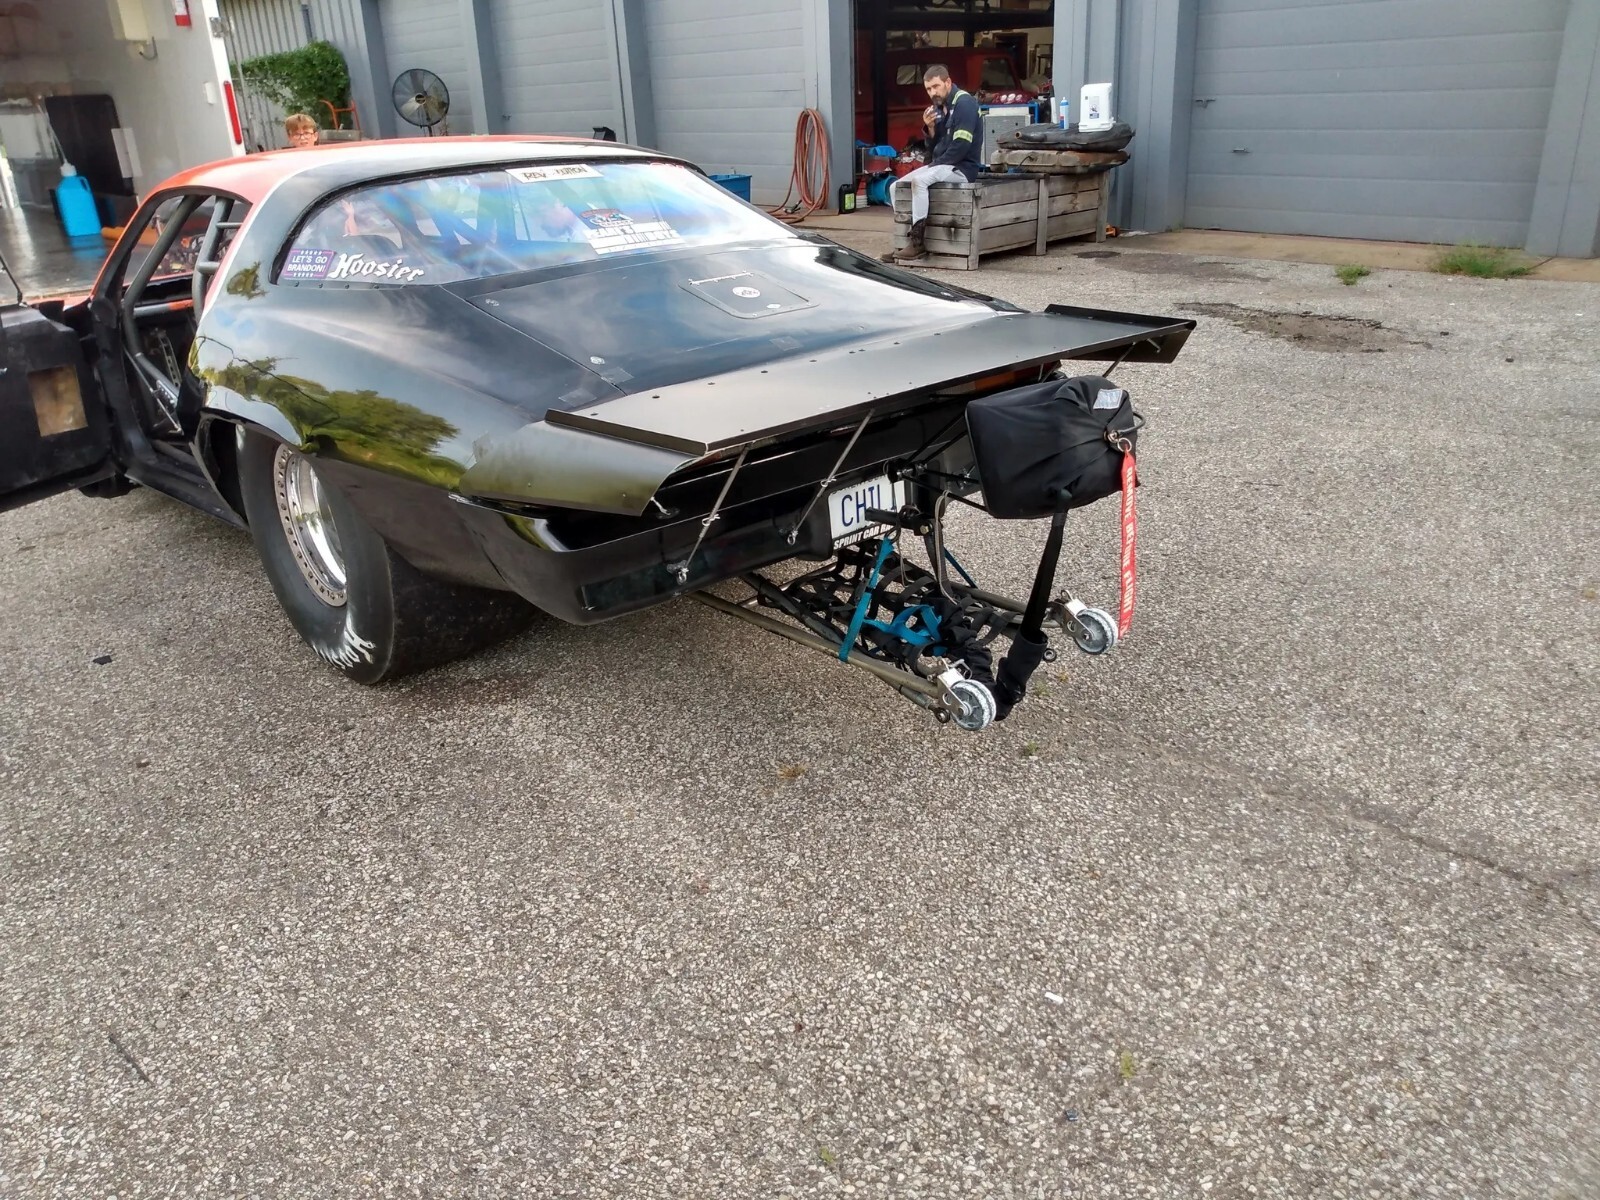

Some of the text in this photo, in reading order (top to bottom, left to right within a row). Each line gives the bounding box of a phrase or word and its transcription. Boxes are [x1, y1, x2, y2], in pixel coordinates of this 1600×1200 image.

[287, 263, 326, 272] BRANDON!
[292, 255, 328, 264] LET'S GO
[327, 253, 425, 282] Hoosier
[841, 483, 898, 527] CHIL
[1124, 467, 1134, 520] REMOVE
[833, 531, 863, 550] SPRINT
[863, 525, 880, 539] CAR
[1123, 522, 1134, 567] BEFORE
[1123, 570, 1134, 613] FLIGHT
